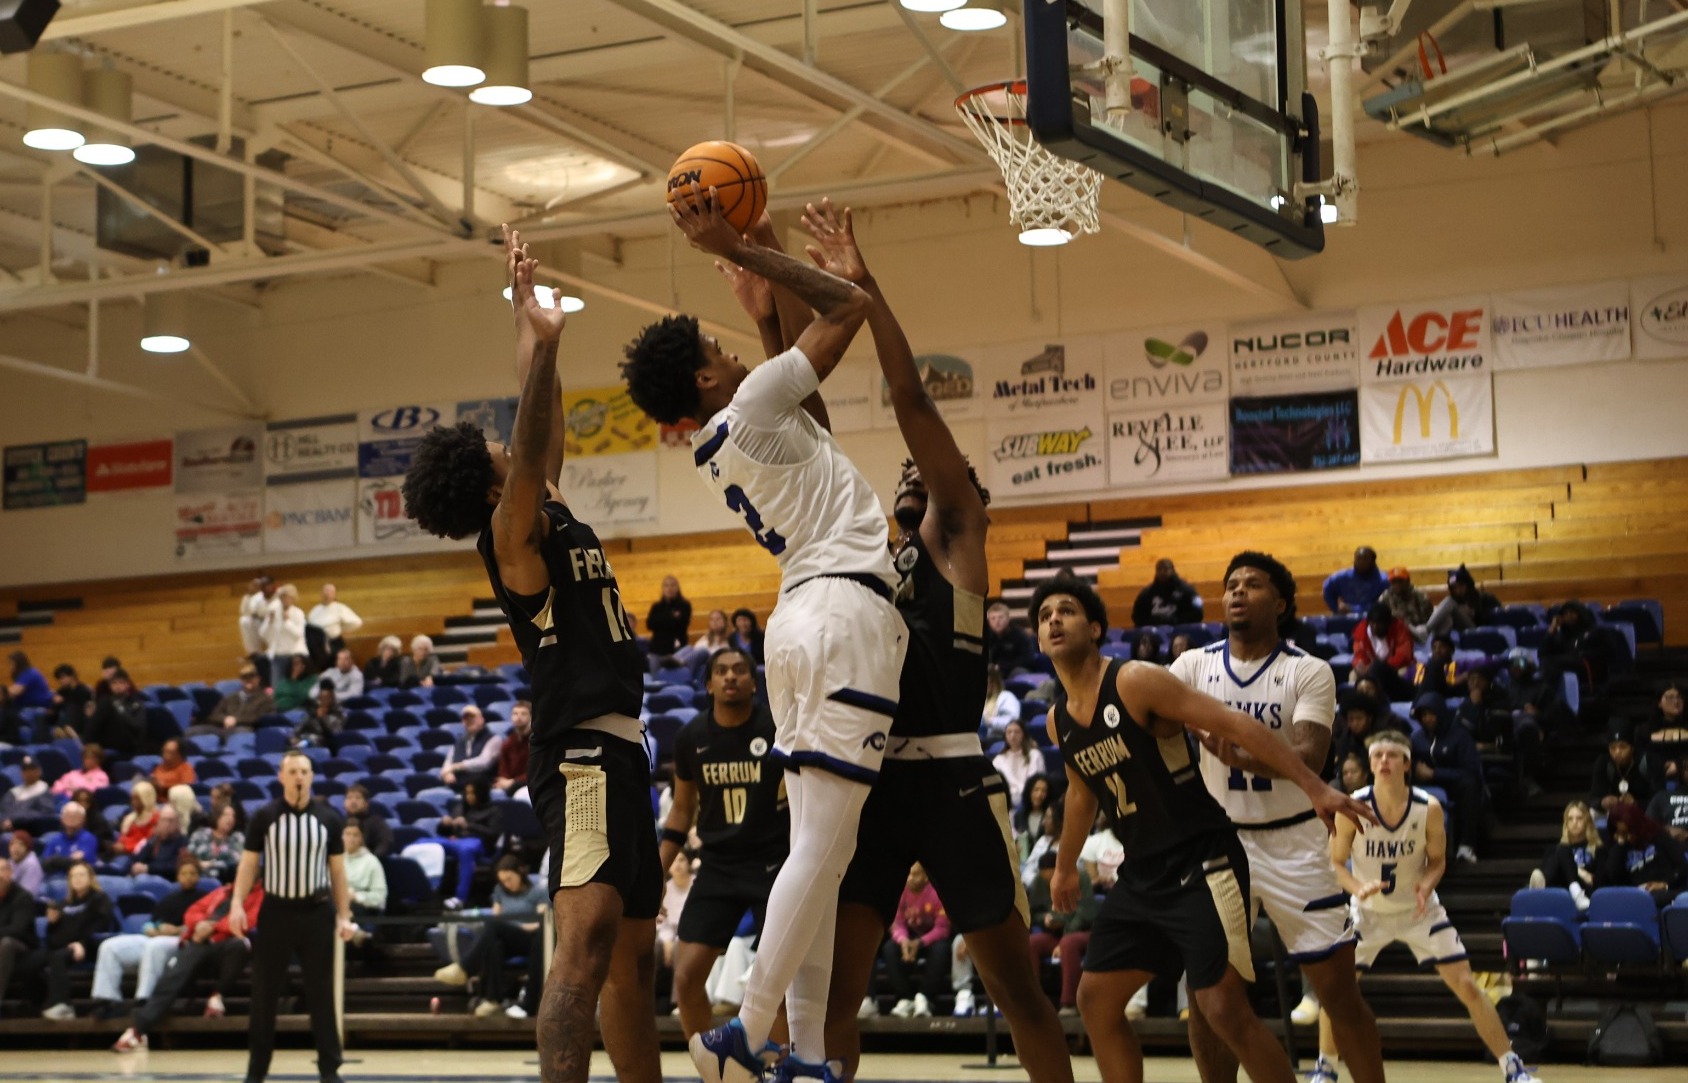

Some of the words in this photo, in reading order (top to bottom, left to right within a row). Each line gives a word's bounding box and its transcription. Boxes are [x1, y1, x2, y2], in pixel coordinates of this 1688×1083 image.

[1368, 308, 1484, 359] ACE
[1512, 313, 1551, 333] ECU
[1554, 306, 1628, 329] HEALTH
[1234, 328, 1350, 354] NUCOR
[1306, 351, 1356, 364] COUNTY
[1376, 355, 1484, 377] Hardware
[993, 377, 1045, 399] Metal
[1049, 372, 1096, 394] Tech
[1110, 370, 1223, 401] enviva
[994, 425, 1092, 463] SUBWAY
[1012, 465, 1040, 485] eat
[1046, 453, 1102, 477] fresh.
[1073, 733, 1132, 777] FERRUM
[702, 761, 761, 785] FERRUM
[723, 787, 747, 825] 10
[1366, 839, 1416, 858] HAWKS
[1381, 863, 1398, 896] 5
